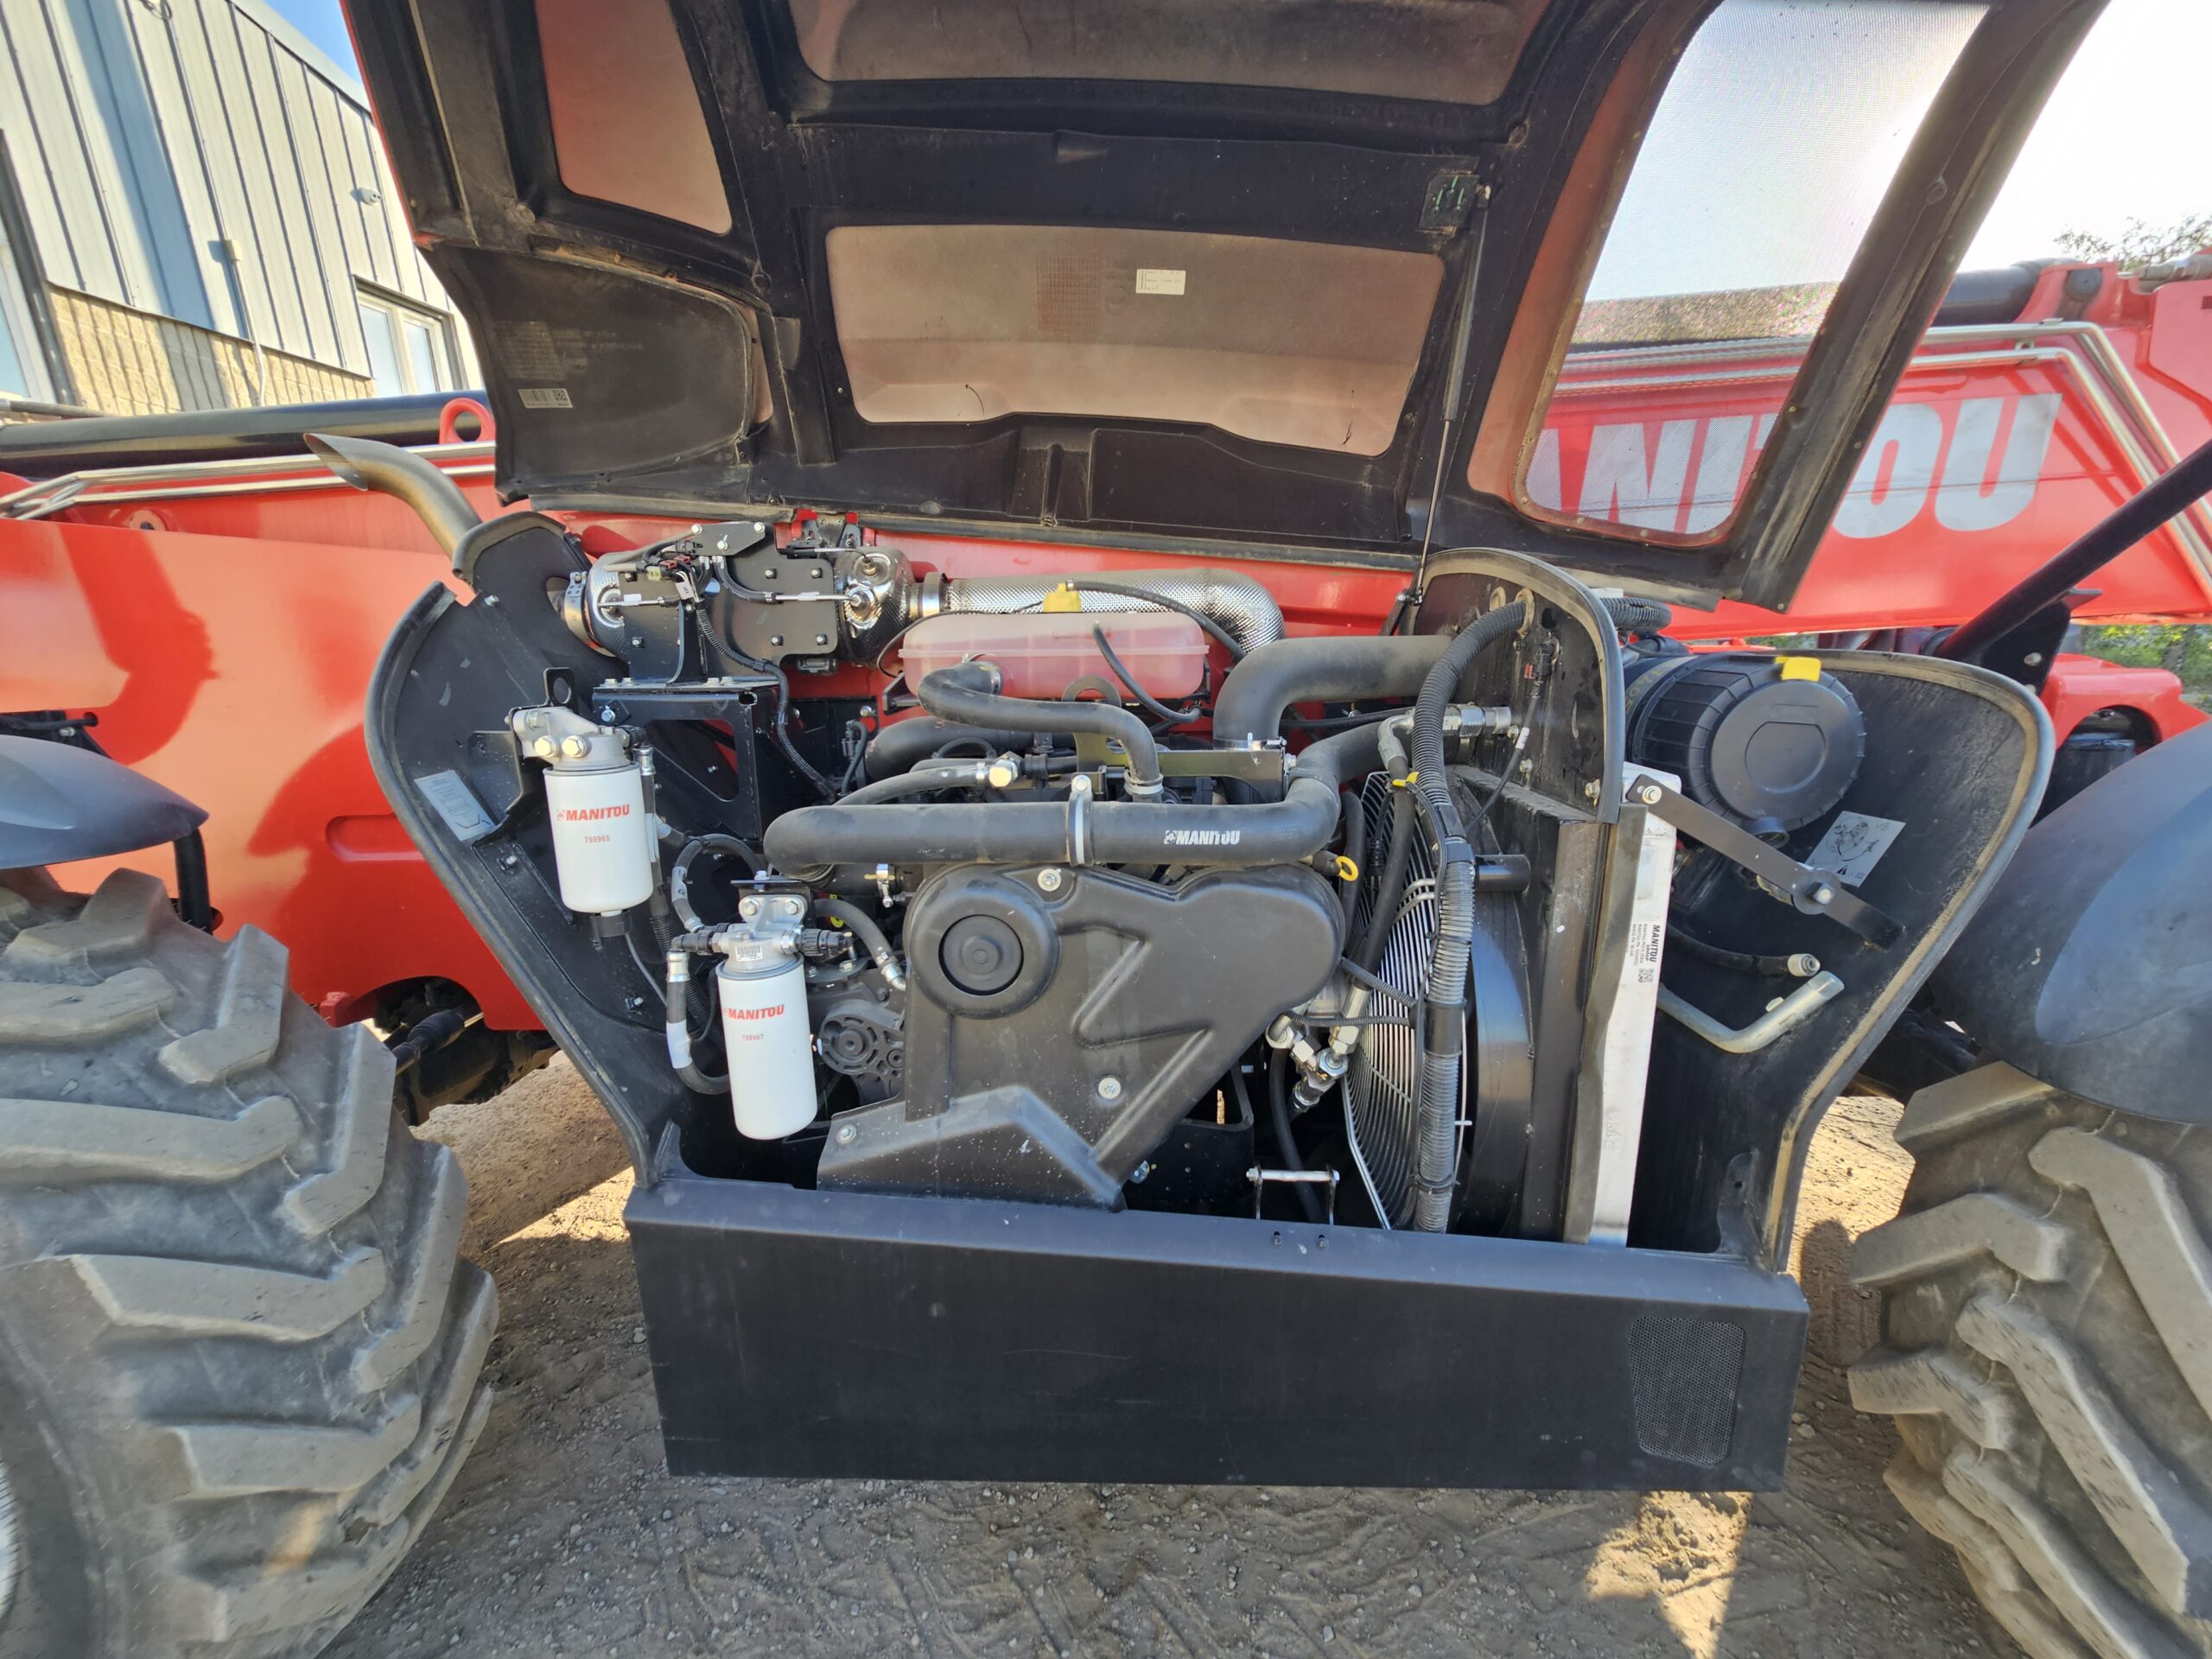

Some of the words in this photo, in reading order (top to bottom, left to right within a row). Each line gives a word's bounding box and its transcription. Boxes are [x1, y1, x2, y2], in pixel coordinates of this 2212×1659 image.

[566, 804, 629, 821] MANITOU
[1176, 830, 1240, 845] MANITOU
[1649, 925, 1660, 962] MANITOU
[728, 1005, 785, 1020] MANITOU
